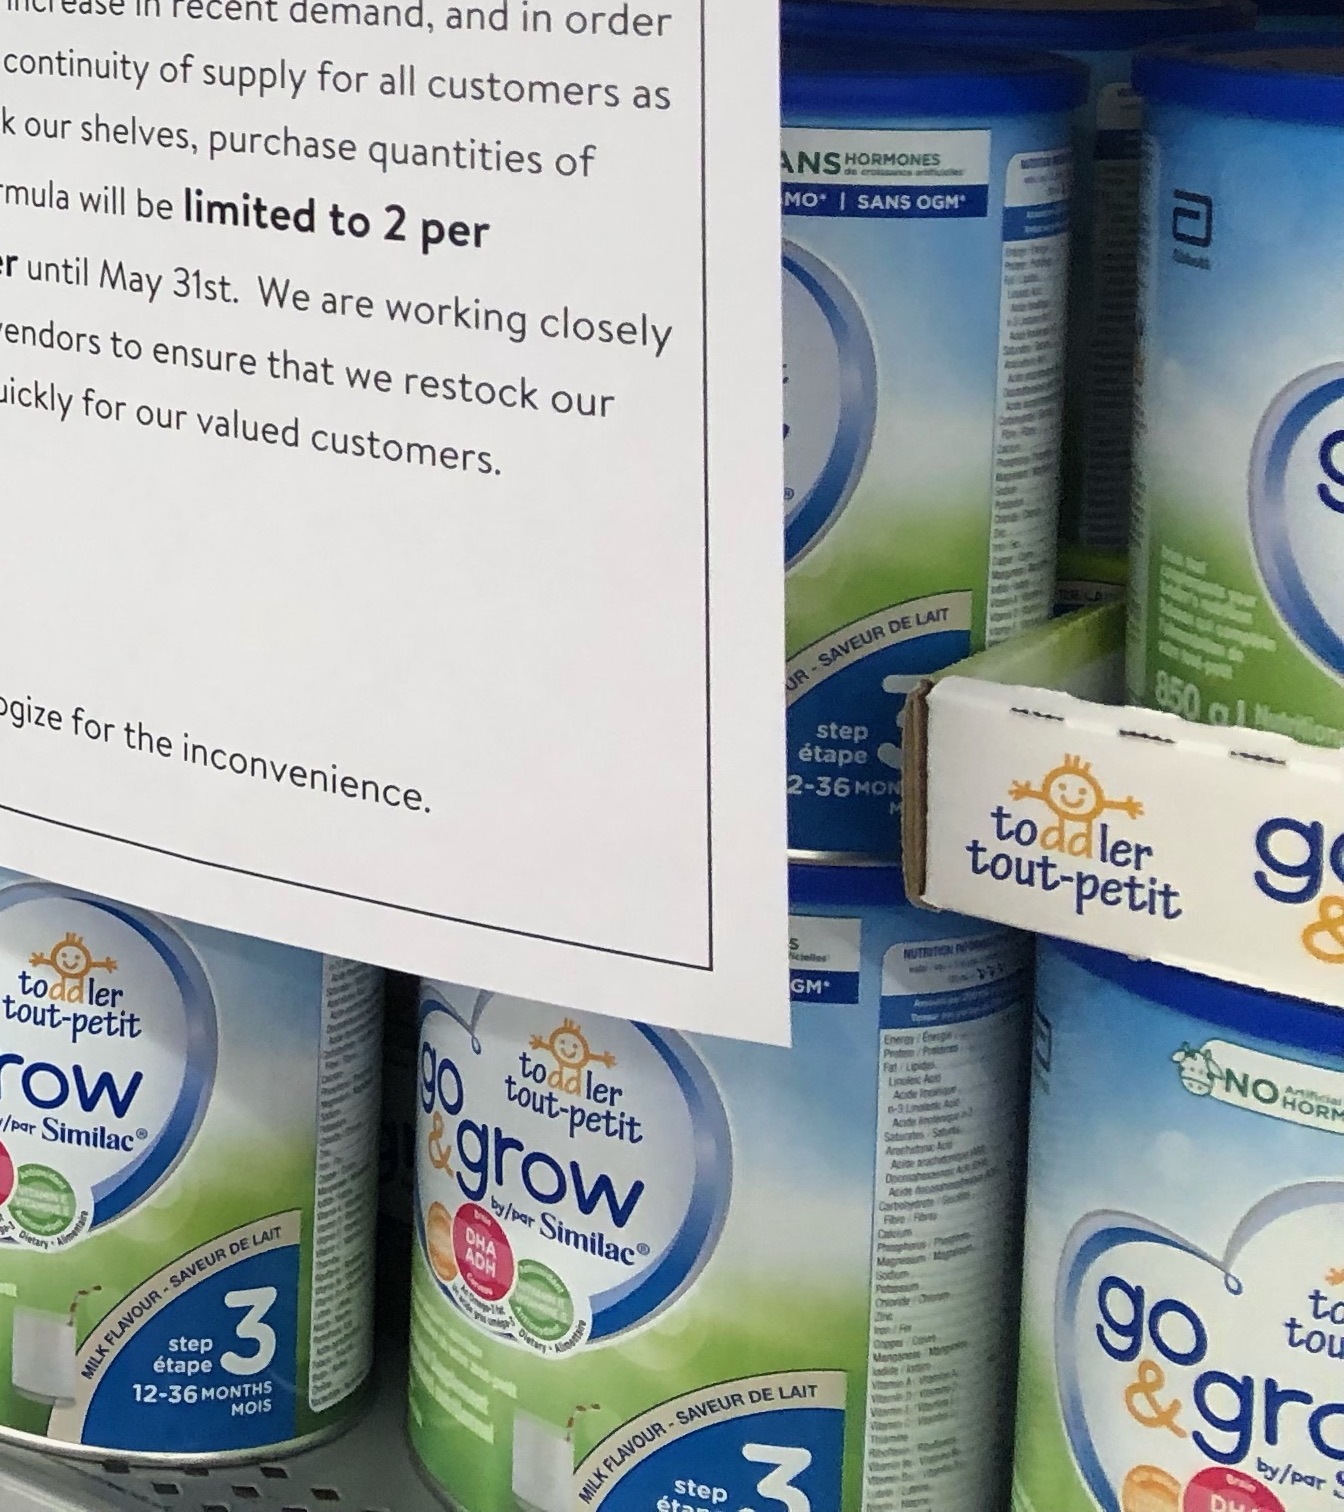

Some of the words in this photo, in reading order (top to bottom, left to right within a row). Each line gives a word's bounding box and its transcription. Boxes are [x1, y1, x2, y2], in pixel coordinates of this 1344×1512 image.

[521, 0, 552, 33] in
[564, 1, 673, 37] order
[3, 47, 150, 91] continuity
[159, 52, 195, 84] of
[202, 58, 307, 100] supply
[316, 59, 369, 94] for
[379, 63, 415, 97] all
[427, 72, 620, 108] customers
[632, 85, 671, 111] as
[24, 116, 73, 140] our
[80, 112, 198, 155] shelves,
[209, 124, 358, 161] purchase
[368, 137, 543, 175] quantities
[554, 143, 598, 178] of
[844, 150, 940, 167] HORMONES
[79, 185, 126, 216] will
[136, 187, 174, 221] be
[184, 186, 316, 234] limited
[328, 203, 371, 239] to
[383, 203, 407, 242] 2
[421, 218, 491, 256] per
[857, 193, 910, 211] SANS
[27, 256, 89, 287] until
[99, 258, 163, 304] May
[172, 266, 239, 304] 31st.
[257, 275, 311, 312] We
[321, 292, 374, 319] are
[385, 295, 527, 344] working
[540, 305, 673, 359] closely
[109, 330, 143, 361] to
[152, 342, 257, 376] ensure
[266, 348, 335, 386] that
[344, 366, 393, 393] we
[404, 372, 540, 411] restock
[551, 390, 616, 418] our
[81, 387, 127, 422] for
[135, 404, 188, 431] our
[196, 408, 300, 448] valued
[311, 429, 501, 477] customers.
[70, 706, 116, 743] for
[123, 721, 173, 758] the
[183, 732, 431, 814] inconvenience.
[991, 808, 1153, 872] toddler
[965, 839, 1182, 922] tout-petit
[2, 994, 141, 1041] tout-petit
[18, 969, 123, 1008] toddler
[168, 1335, 213, 1360] step
[220, 1286, 278, 1375] 3
[132, 1383, 198, 1405] 12-36
[202, 1381, 272, 1403] MONTHS
[154, 1354, 213, 1377] étape
[232, 1398, 272, 1417] MOIS
